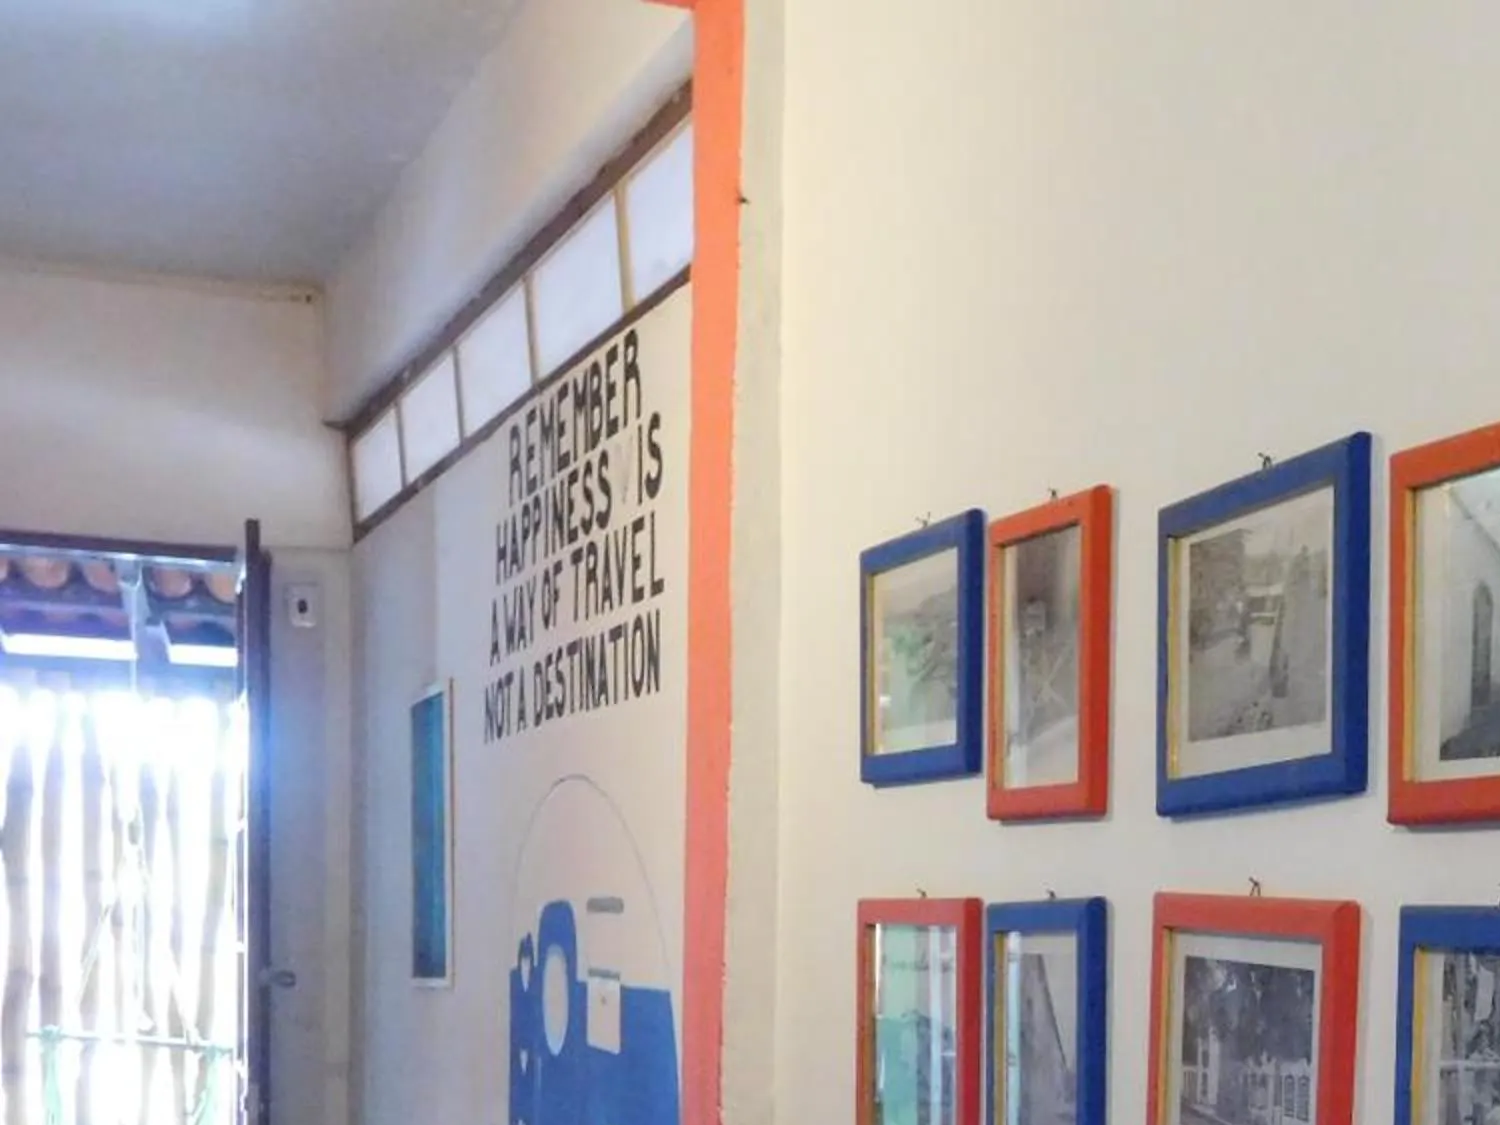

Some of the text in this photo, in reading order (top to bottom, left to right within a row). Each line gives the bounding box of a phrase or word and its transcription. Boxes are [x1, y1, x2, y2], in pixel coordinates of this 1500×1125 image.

[496, 411, 663, 586] HAPPINESS IS
[508, 329, 642, 508] REMEMBER
[489, 511, 665, 667] A WAY OF TRAVEL
[484, 609, 661, 745] NOT A DESTINATION
